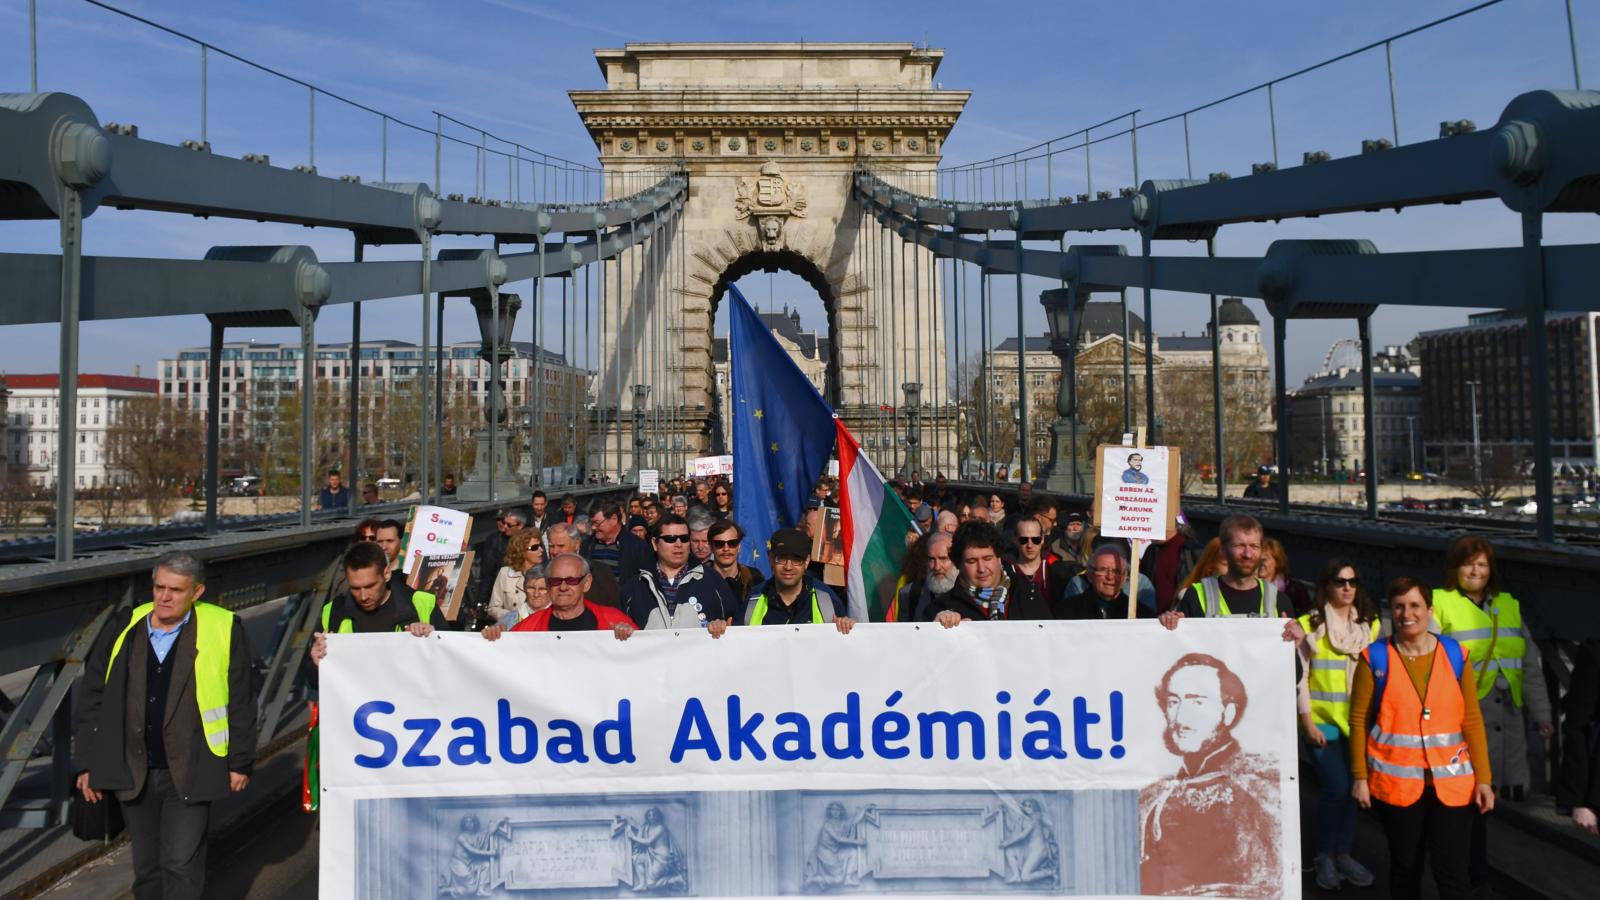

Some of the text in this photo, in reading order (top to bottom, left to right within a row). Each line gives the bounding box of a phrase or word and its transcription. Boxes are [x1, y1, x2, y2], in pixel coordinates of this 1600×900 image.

[431, 513, 453, 526] Save
[426, 532, 449, 544] Our
[354, 689, 1126, 768] Szabad Akadémiát!
